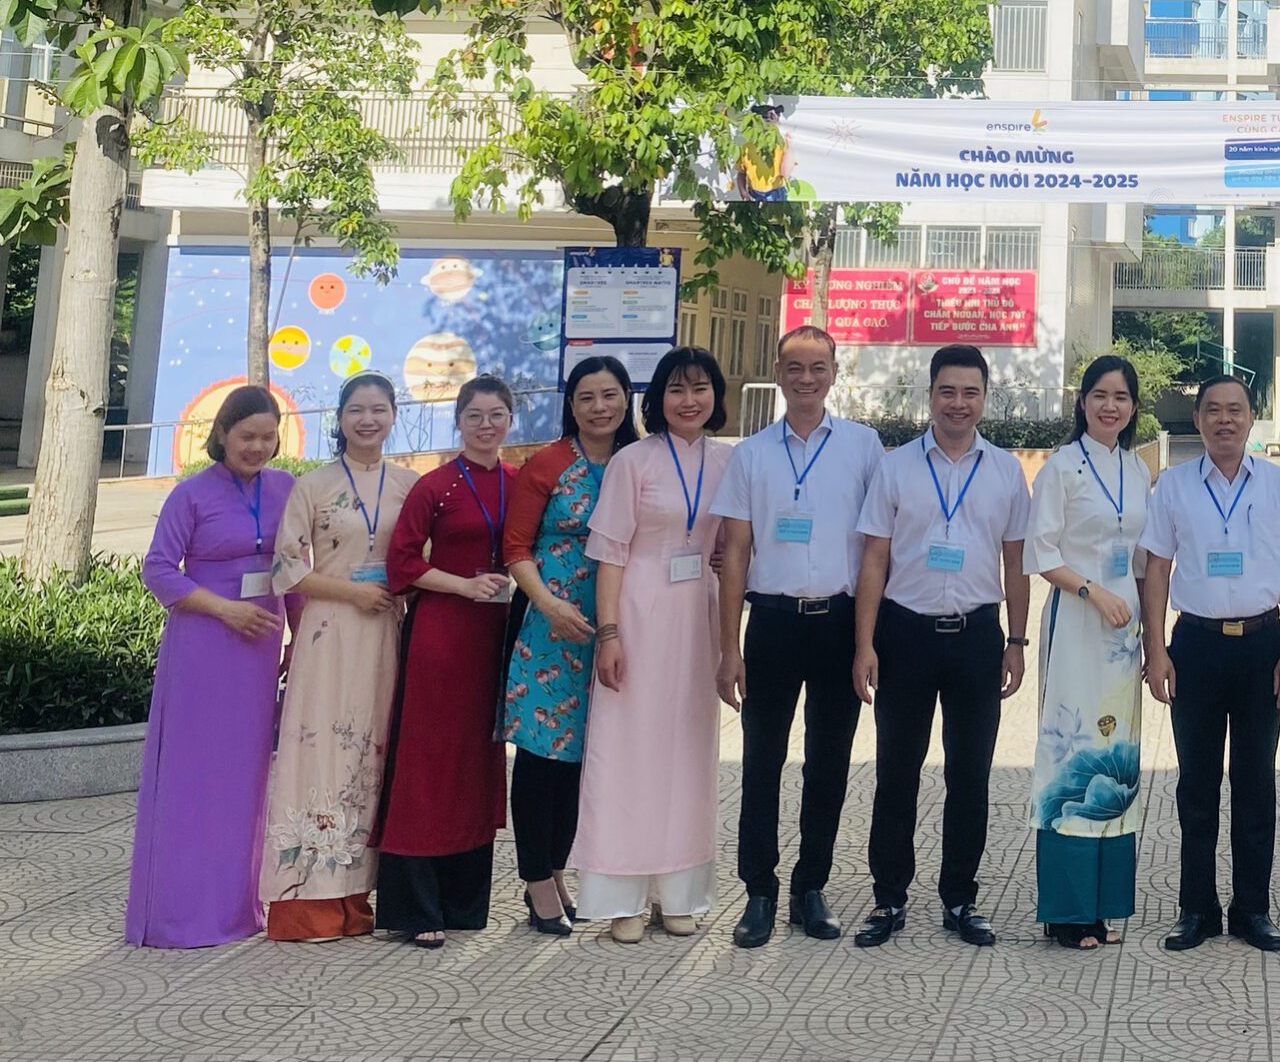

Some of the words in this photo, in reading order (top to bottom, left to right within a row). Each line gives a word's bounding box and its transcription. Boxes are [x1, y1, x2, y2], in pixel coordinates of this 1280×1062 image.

[1222, 114, 1267, 123] ENSPIRE
[986, 122, 1031, 133] enspire
[959, 146, 1010, 163] CHÀO
[1016, 145, 1074, 163] MỪNG
[896, 169, 941, 187] NĂM
[946, 173, 985, 191] HỌC
[990, 169, 1029, 188] MỚI
[1034, 174, 1139, 188] 2024-2025
